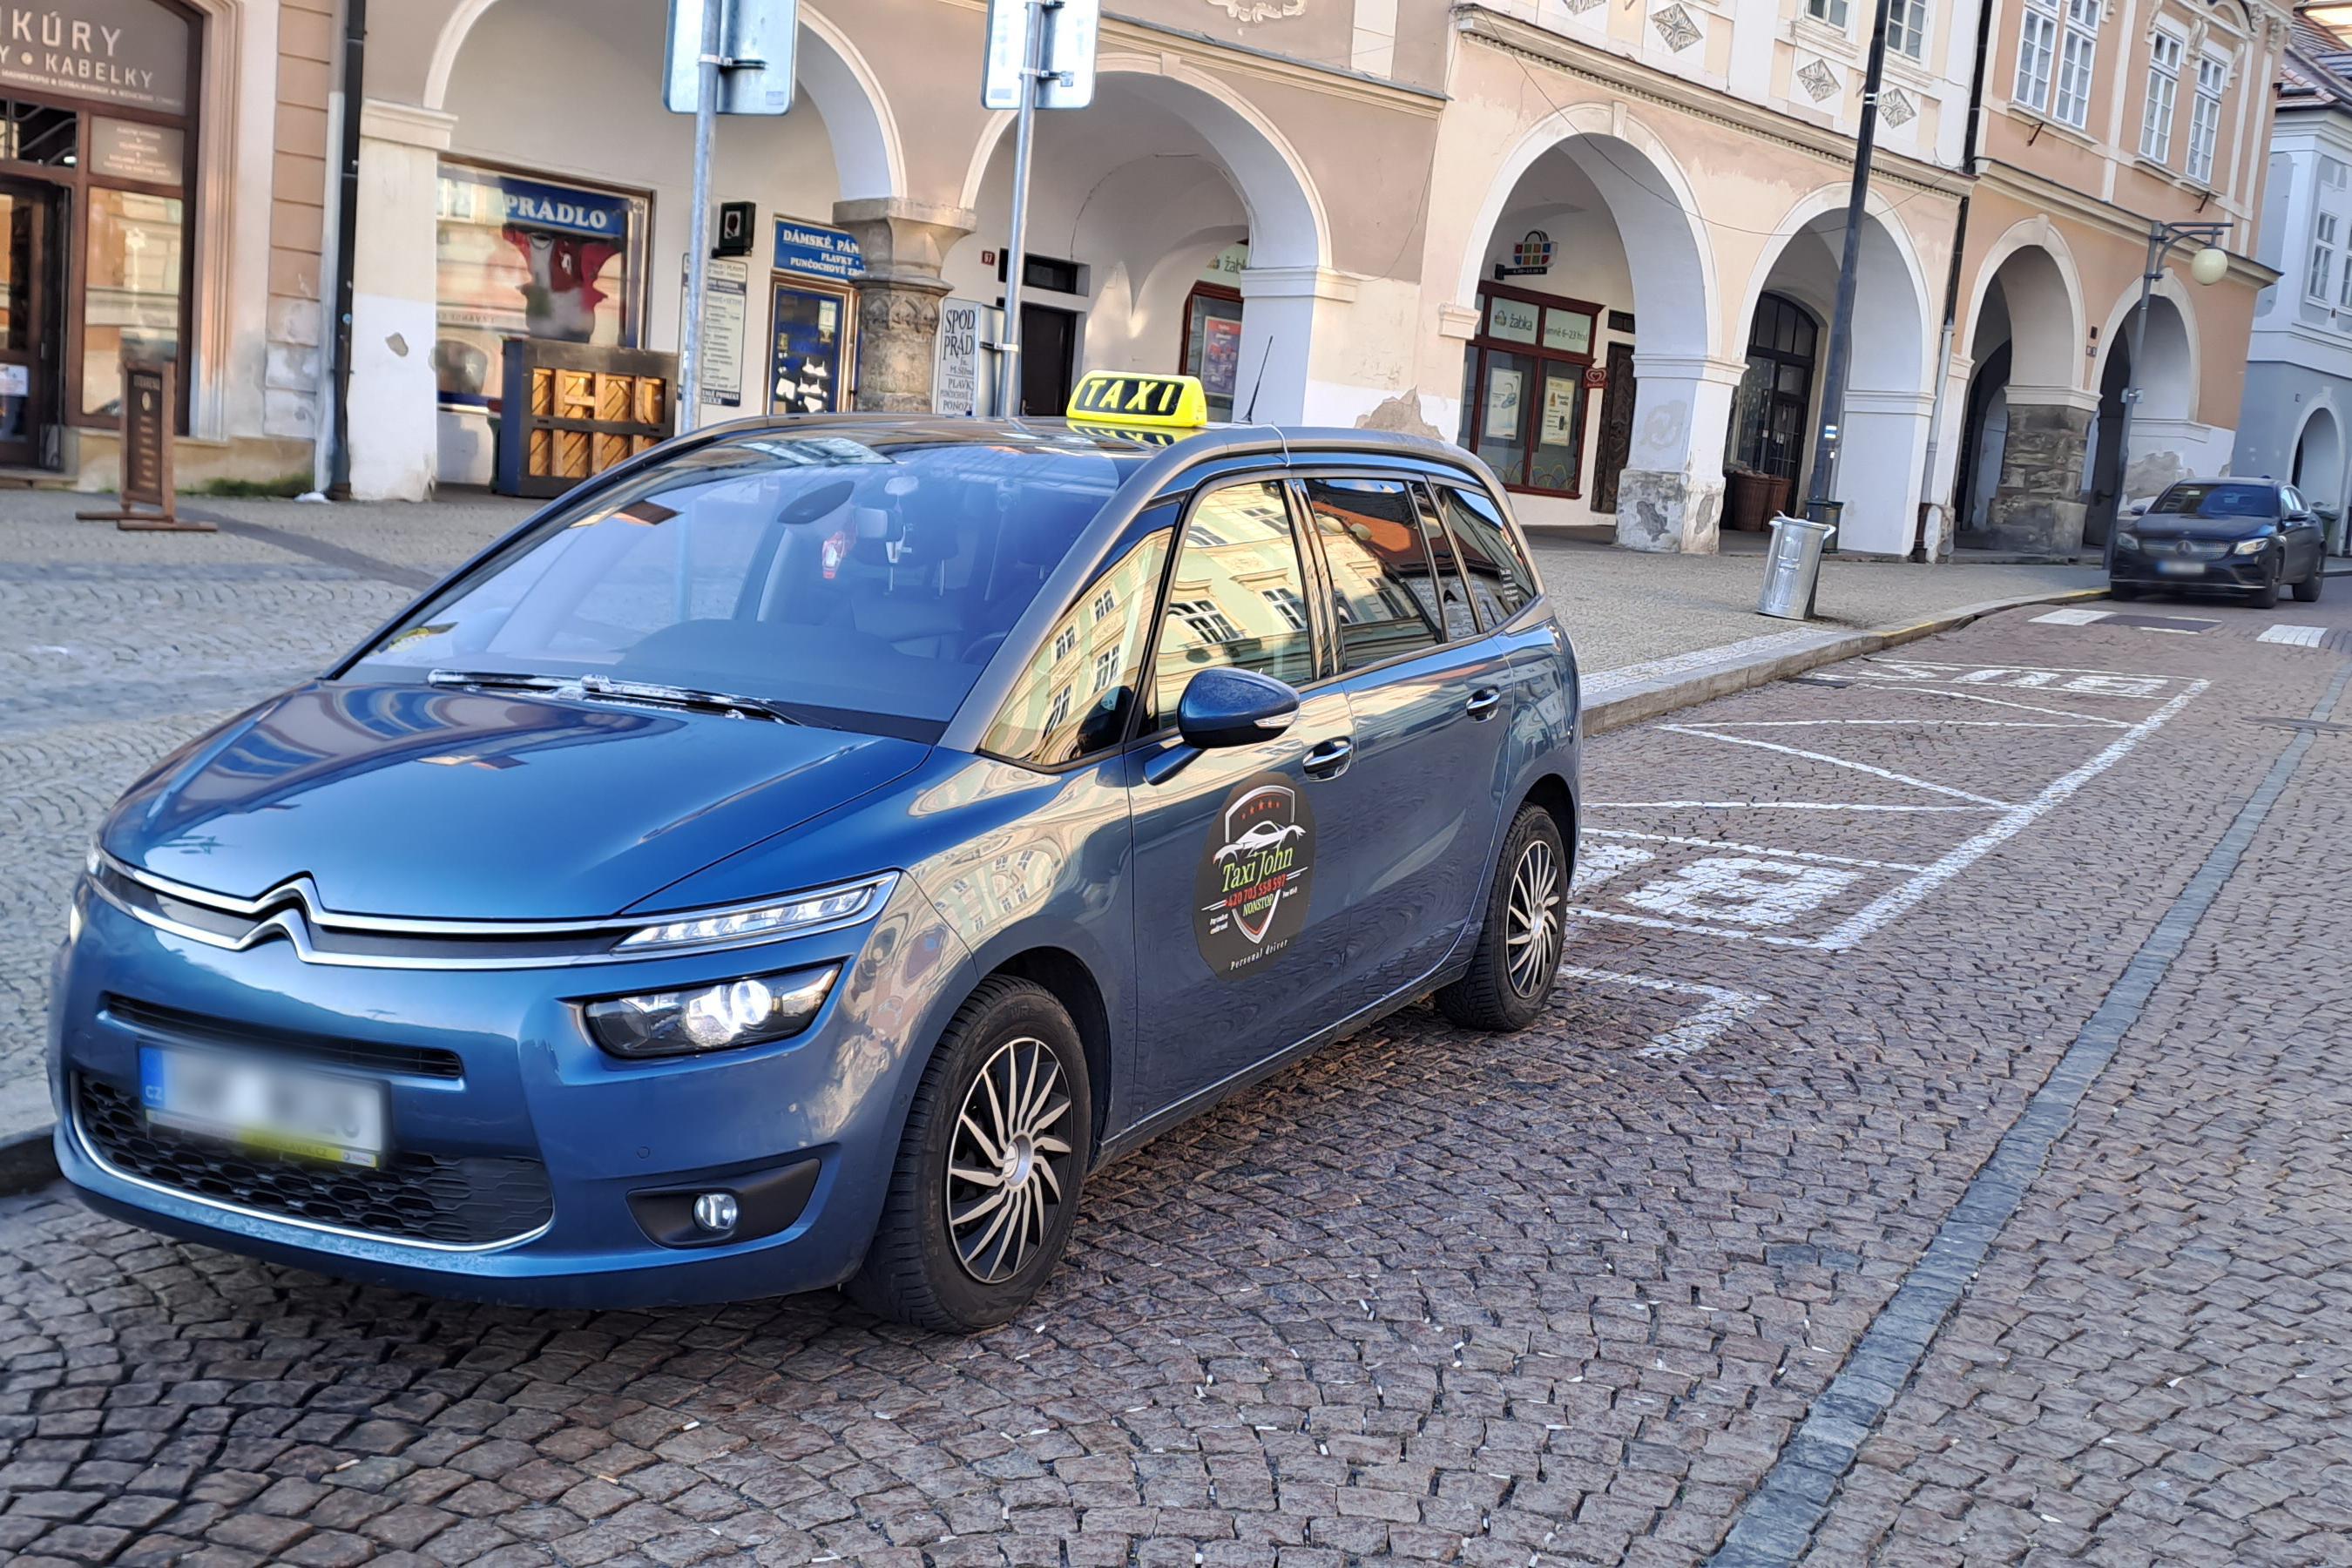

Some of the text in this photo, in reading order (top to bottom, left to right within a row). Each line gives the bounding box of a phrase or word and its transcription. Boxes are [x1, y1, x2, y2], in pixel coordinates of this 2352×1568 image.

[0, 7, 121, 57] KÚRY
[45, 53, 153, 88] KABELKY
[504, 193, 607, 229] PRÁDLO
[783, 229, 835, 250] DÁMSKÉ,
[790, 257, 846, 274] PUNČOCHOVÉ
[821, 253, 854, 265] PLAVKY
[1509, 314, 1533, 331] žabka
[1084, 380, 1175, 412] TAXI
[1222, 841, 1293, 892] Taxi John
[1243, 894, 1274, 916] NONSTOP
[1230, 939, 1288, 970] Personal driver
[145, 1085, 162, 1101] CZ
